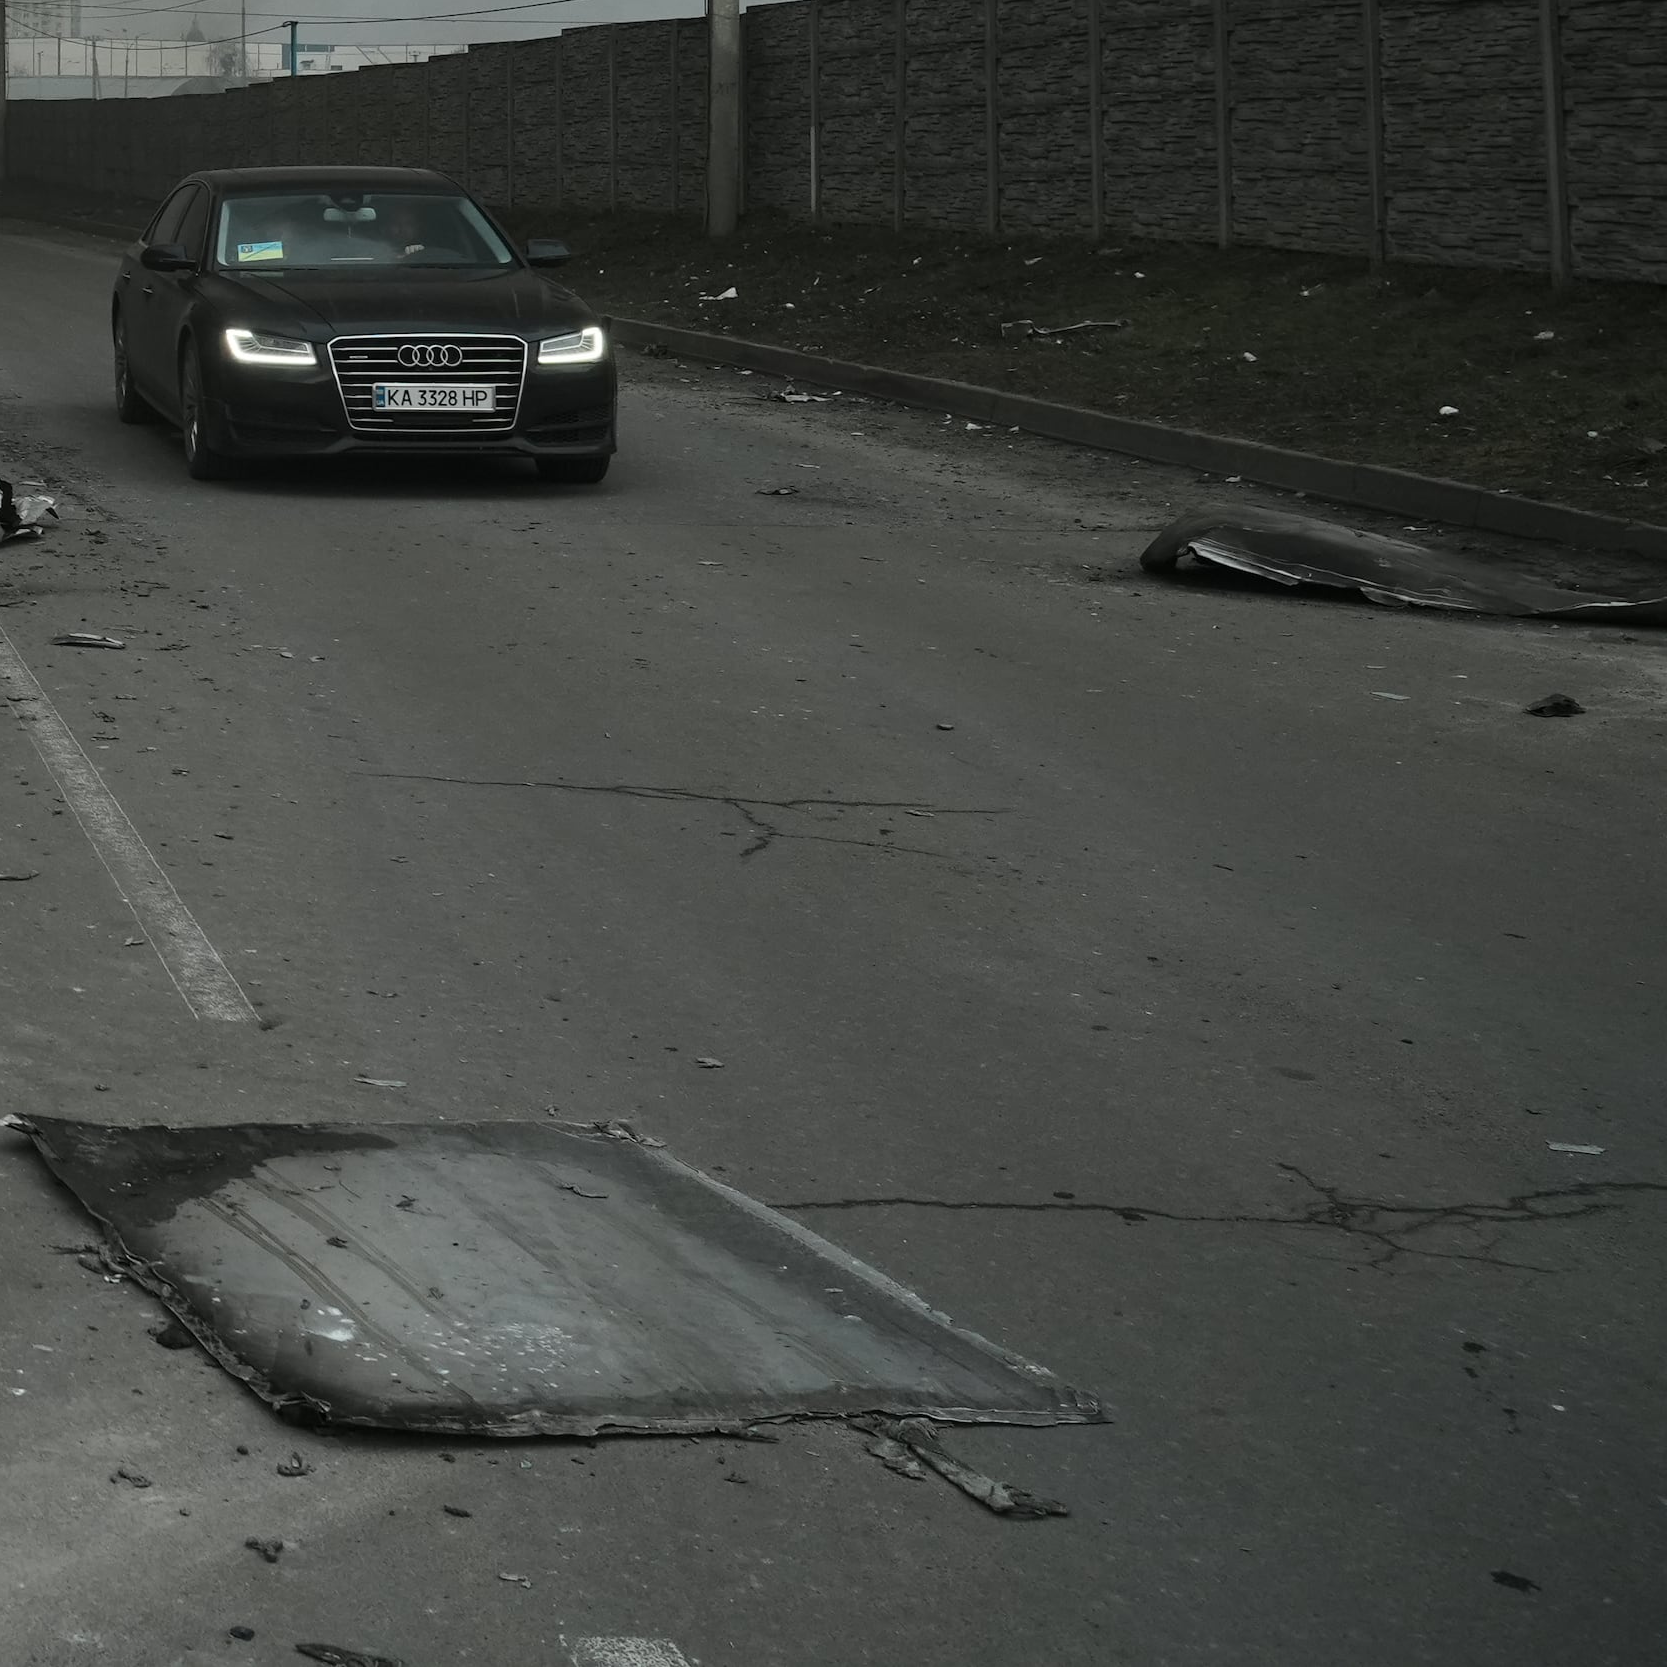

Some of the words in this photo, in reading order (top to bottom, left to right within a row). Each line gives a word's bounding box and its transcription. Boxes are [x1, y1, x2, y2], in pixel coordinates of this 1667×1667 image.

[388, 390, 412, 406] KA
[418, 390, 458, 406] 3328
[463, 390, 488, 406] HP
